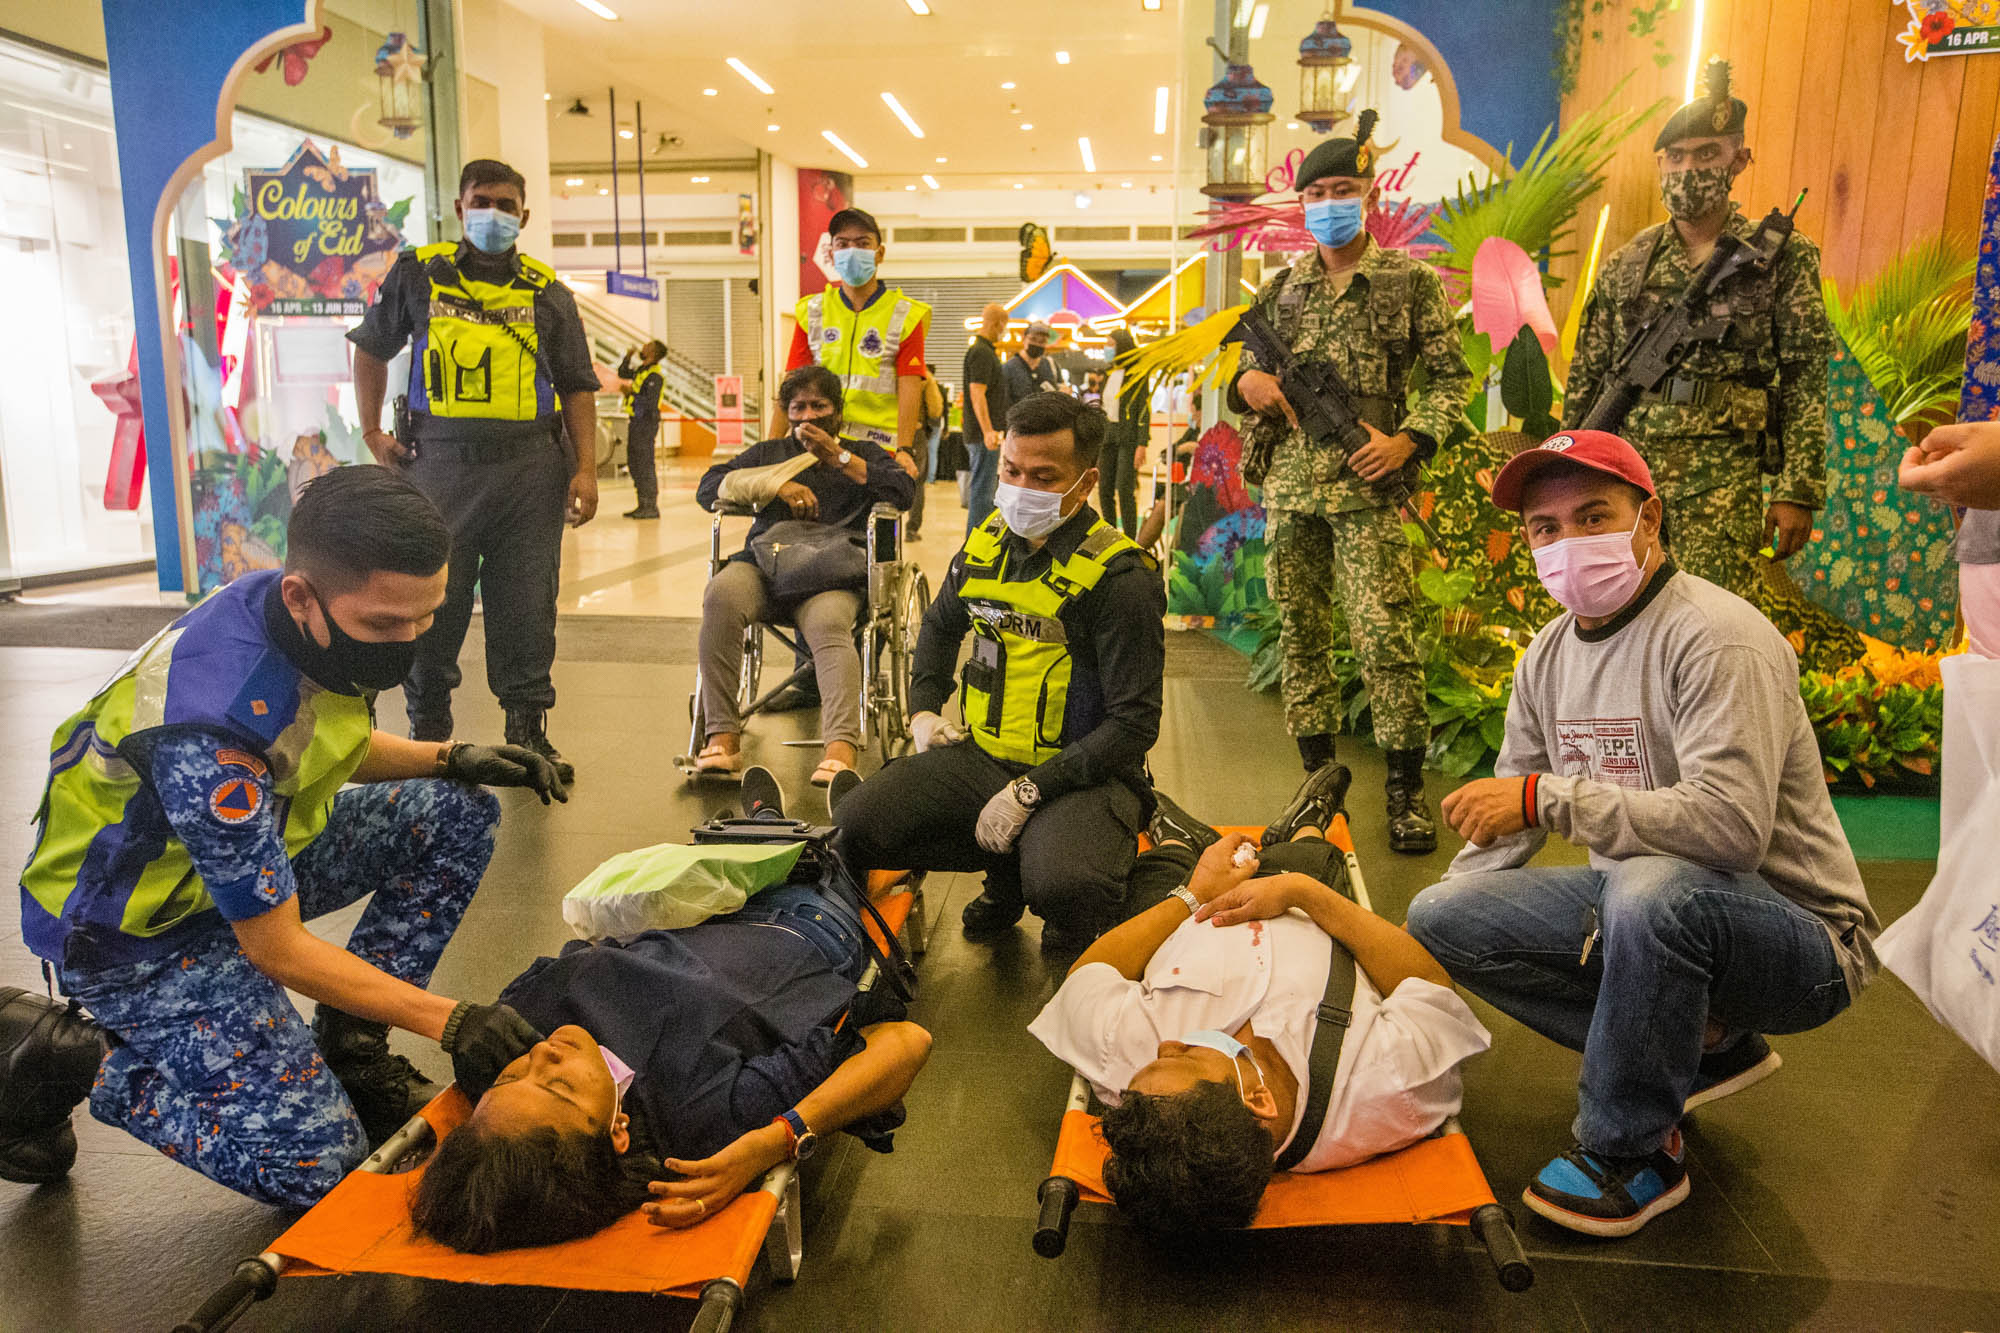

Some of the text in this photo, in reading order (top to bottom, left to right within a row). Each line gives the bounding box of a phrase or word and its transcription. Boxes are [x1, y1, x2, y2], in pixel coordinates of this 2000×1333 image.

[1946, 33, 1962, 47] 16
[1963, 31, 1989, 45] APR
[256, 179, 359, 221] Colours
[293, 220, 365, 264] of Eid
[283, 302, 302, 314] APR
[312, 302, 324, 314] 13
[325, 302, 342, 314] JUN
[866, 430, 892, 444] PDRM
[999, 614, 1042, 638] DRM
